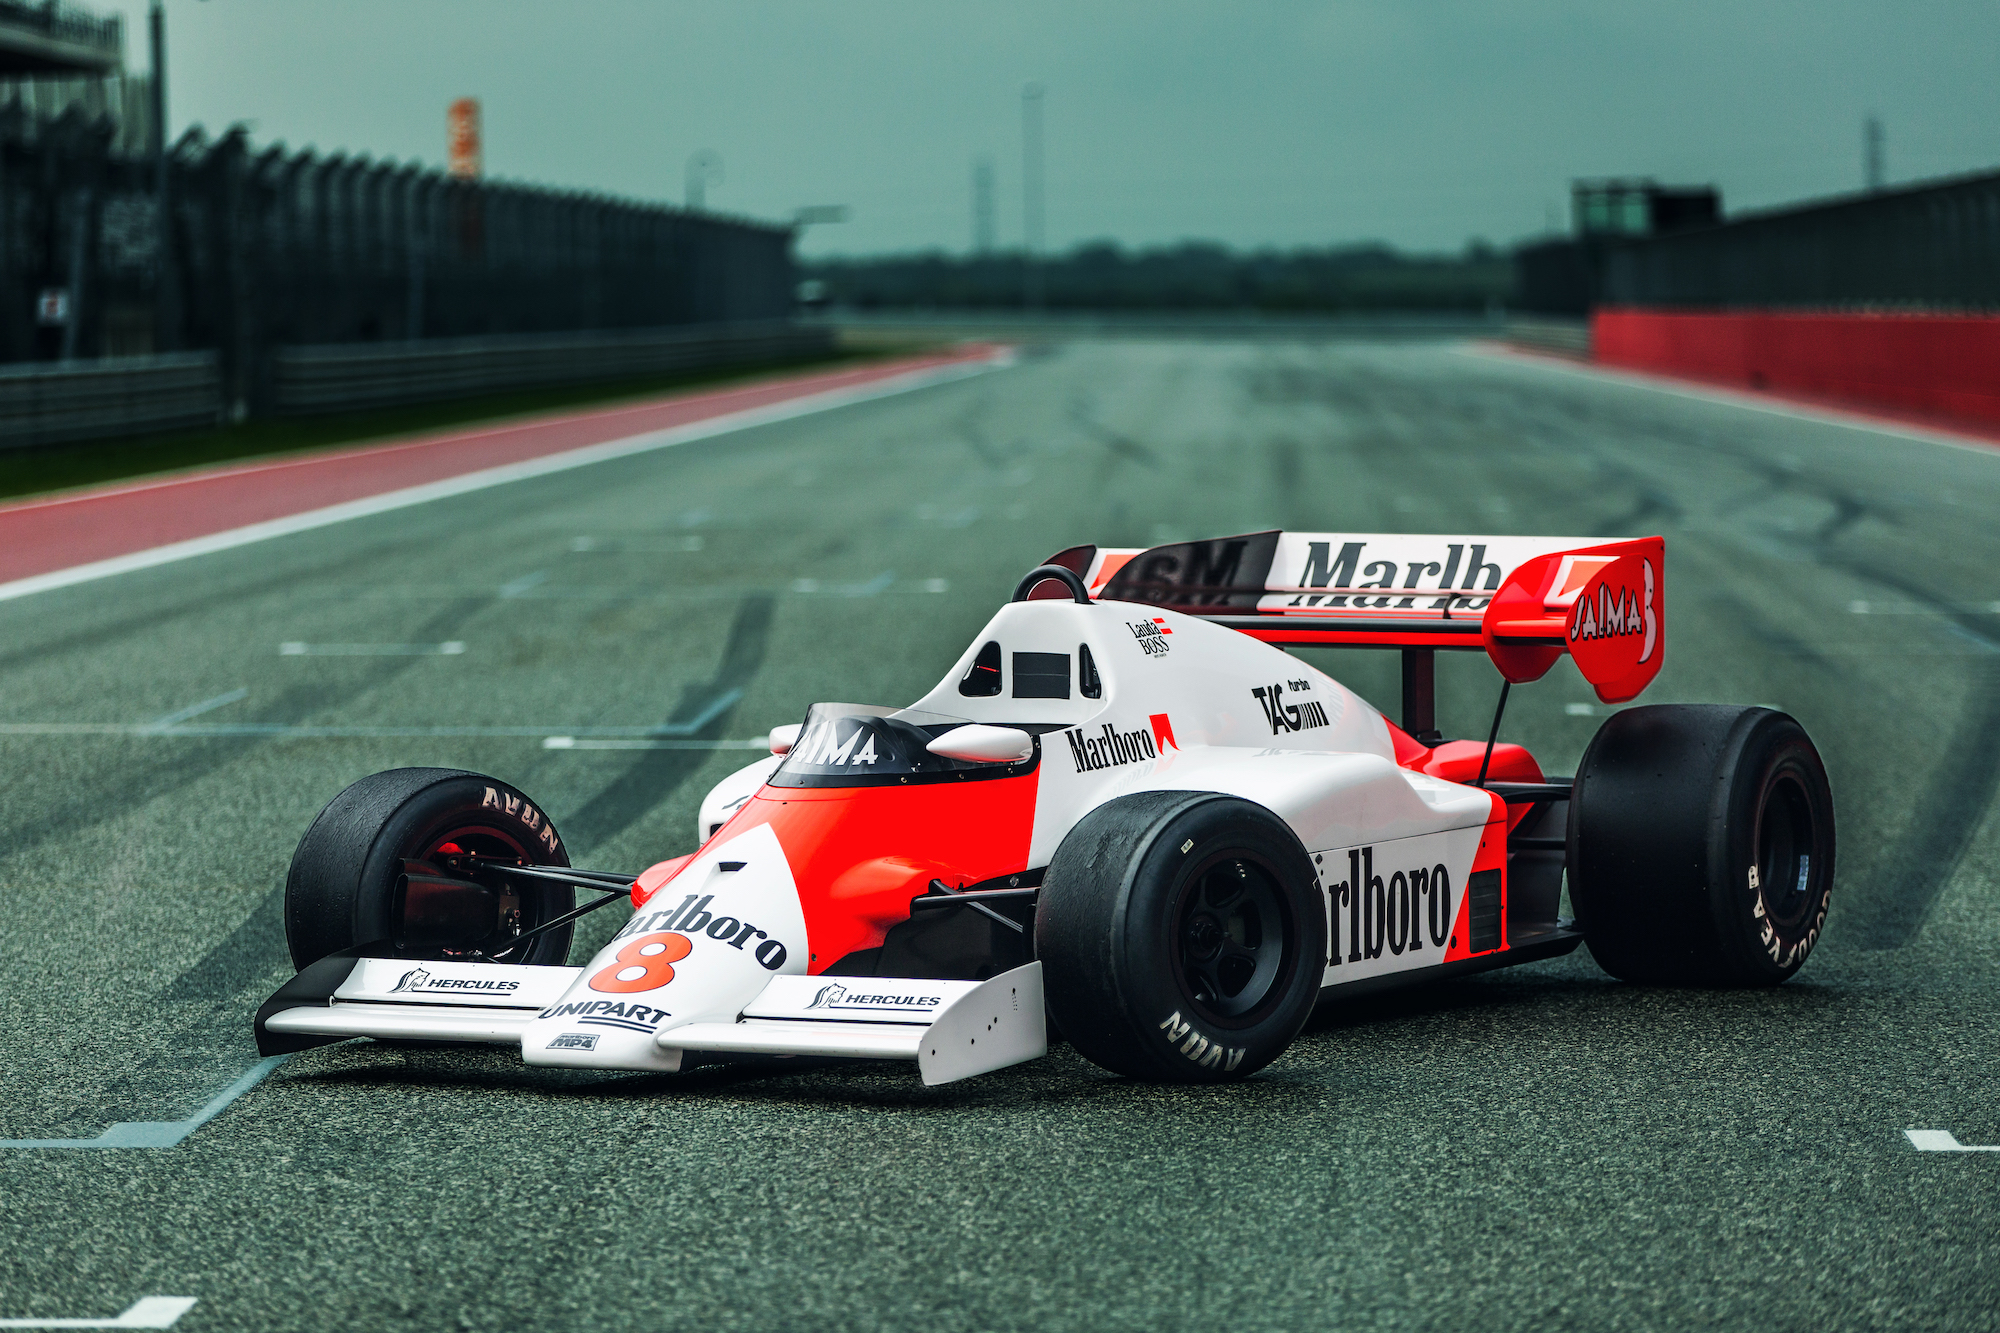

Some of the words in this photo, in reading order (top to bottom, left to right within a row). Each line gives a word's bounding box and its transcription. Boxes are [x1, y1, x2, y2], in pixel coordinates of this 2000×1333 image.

[1125, 619, 1162, 638] Lauda
[1571, 581, 1642, 642] SAIMA
[1138, 635, 1170, 655] BOSS
[1287, 678, 1311, 692] turbo
[1251, 682, 1304, 736] TAG
[1064, 723, 1156, 774] Marlboro
[481, 785, 559, 854] AVON
[1328, 846, 1451, 968] rlboro
[588, 931, 693, 994] 8
[427, 979, 521, 991] HERCULES
[844, 994, 942, 1006] HERCULES
[538, 1000, 672, 1024] UNIPART
[550, 1038, 593, 1049] MP4
[1159, 1010, 1247, 1072] AVON
